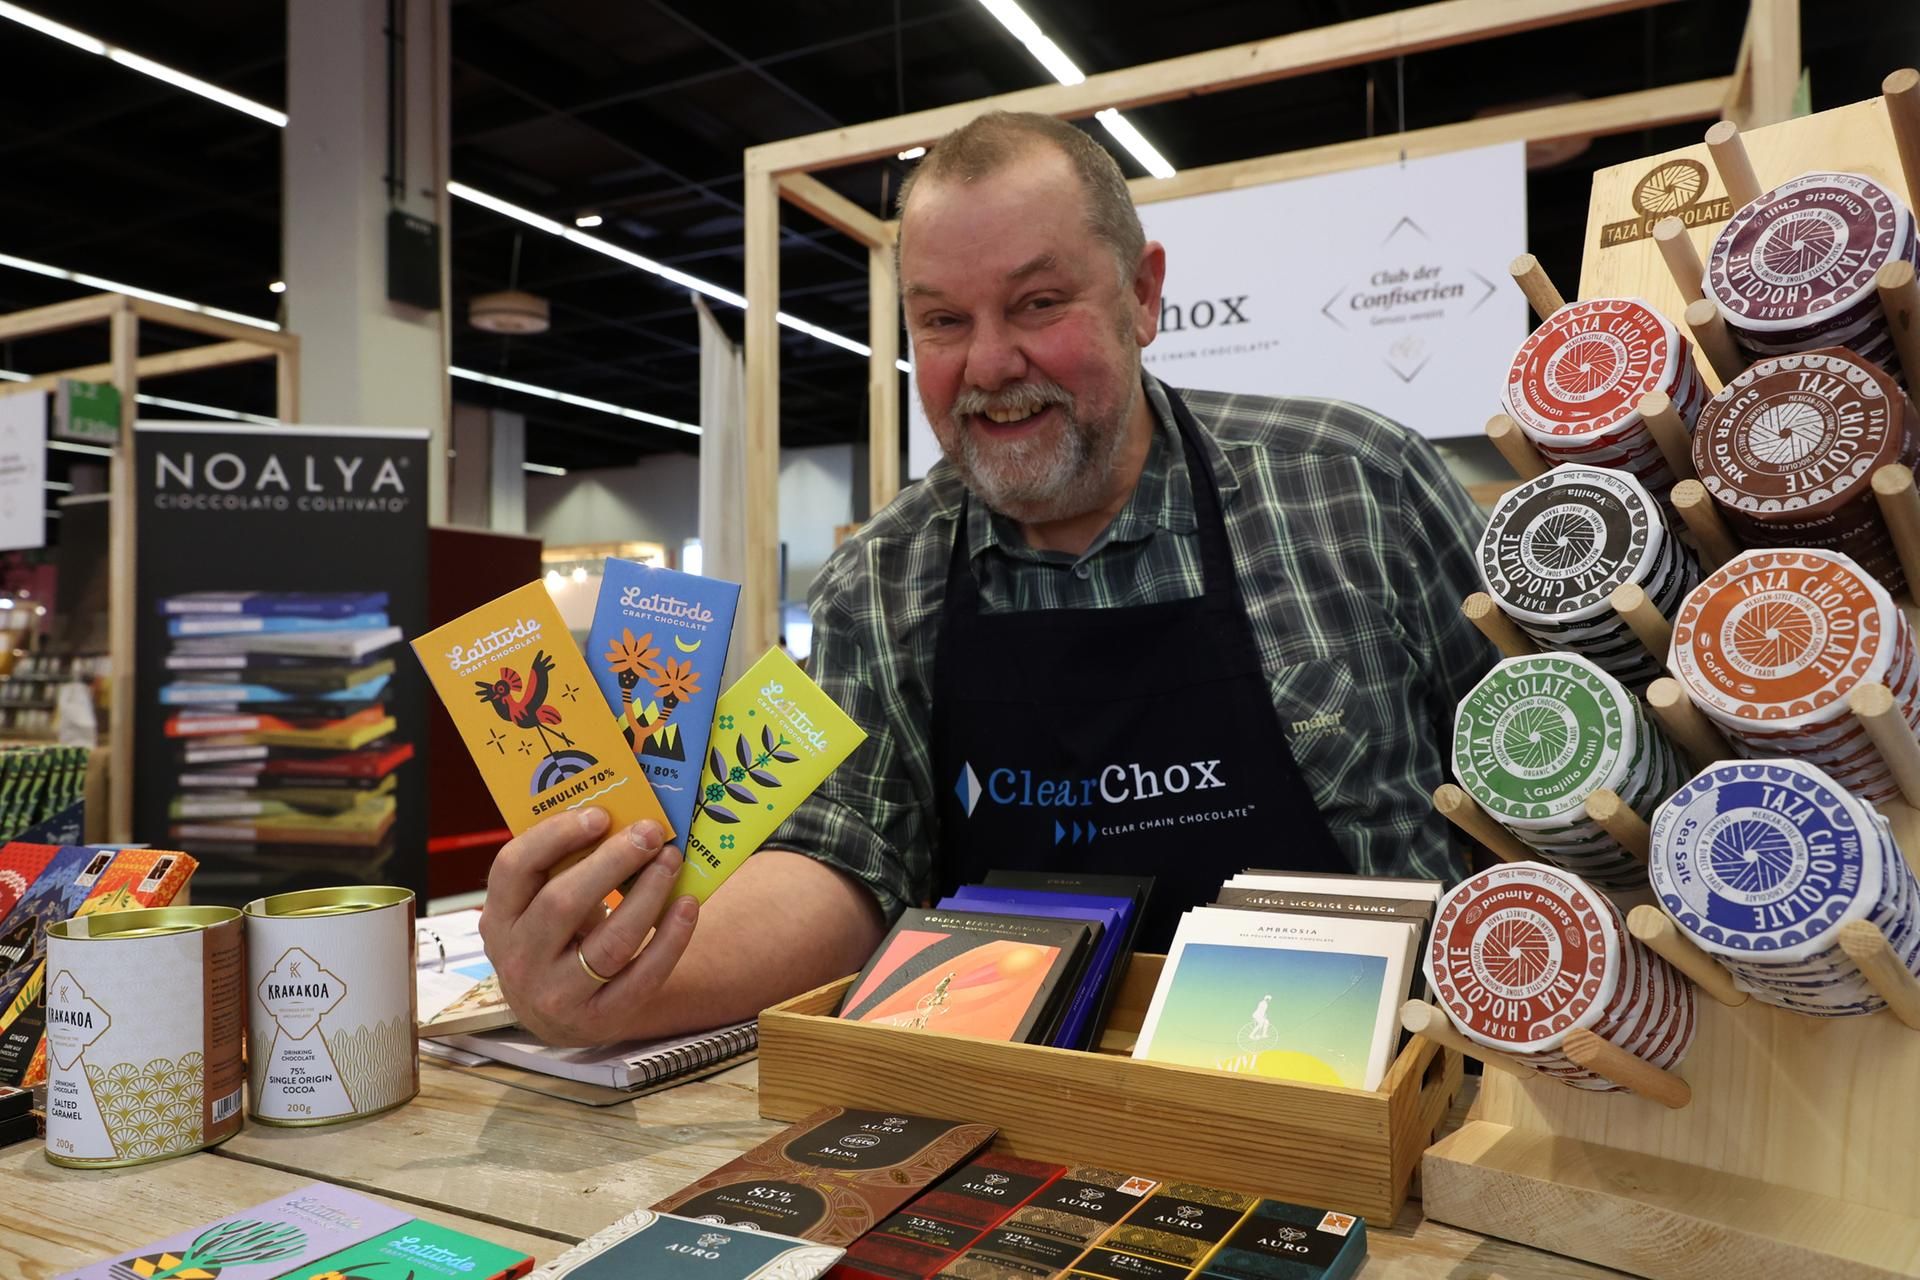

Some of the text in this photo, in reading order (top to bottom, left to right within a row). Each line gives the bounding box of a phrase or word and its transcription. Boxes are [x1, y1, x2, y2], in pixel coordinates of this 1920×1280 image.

[1764, 192, 1864, 219] Chipotle Chili
[1607, 223, 1638, 242] TAZA
[1370, 265, 1442, 288] Club der
[1730, 252, 1813, 304] CHOCOLATE
[1820, 249, 1864, 288] TAZA
[1350, 280, 1465, 312] Confiserien
[1633, 311, 1657, 333] DARK
[1759, 306, 1794, 317] DARK
[1560, 316, 1648, 398] TAZA CHOCOLATE
[1528, 379, 1563, 417] Cinnamon
[1797, 373, 1846, 402] TAZA
[1715, 389, 1760, 484] SUPER DARK
[1866, 408, 1884, 441] DARK
[1785, 401, 1864, 494] CHOCOLATE
[155, 493, 289, 511] CIOCCOLATO
[1567, 488, 1607, 506] Vanilla
[1542, 508, 1559, 519] TRADE
[1501, 533, 1564, 598] CHOCOLATE
[1574, 556, 1619, 591] TAZA
[1832, 572, 1866, 601] DARK
[620, 586, 714, 622] Latitude
[1515, 594, 1546, 611] DARK
[1744, 593, 1792, 608] MEXICAN-STYLE
[622, 609, 707, 631] CRAFT CHOCOLATE
[1736, 571, 1855, 679] TAZA CHOCOLATE
[444, 618, 542, 671] Latitude
[460, 633, 543, 677] CRAFT CHOCOLATE
[1703, 652, 1734, 688] Coffee
[1754, 669, 1776, 677] TRADE
[1472, 679, 1499, 706] DARK
[757, 698, 817, 757] CRAFT CHOCOLATE
[761, 679, 828, 752] Latitude
[1473, 677, 1576, 779] TAZA CHOCOLATE
[653, 766, 679, 779] 80%
[1523, 768, 1550, 776] ORGANIC
[1558, 747, 1574, 766] DIRECT
[1534, 770, 1581, 797] Guajillo
[1579, 739, 1598, 767] Chili
[532, 768, 615, 815] SEMULIKI 70%
[1101, 823, 1135, 836] CLEAR
[1140, 817, 1174, 830] CHAIN
[688, 833, 720, 869] COFFEE
[1675, 817, 1697, 885] Sea Salt
[1753, 786, 1837, 929] TAZA CHOCOLATE
[1838, 863, 1859, 892] DARK
[1482, 889, 1572, 926] Salted Almond
[1486, 914, 1503, 928] TRADE
[1506, 910, 1527, 918] DIRECT
[1257, 926, 1319, 936] AMBROSIA
[268, 983, 329, 1000] KRAKAKOA
[1450, 947, 1532, 1022] CHOCOLATE
[1538, 969, 1581, 1012] TAZA
[1482, 1018, 1516, 1039] DARK
[269, 1074, 332, 1085] SINGLE ORIGIN
[283, 1086, 315, 1094] COCOA
[51, 1108, 82, 1120] CARAMEL
[54, 1097, 77, 1109] SALTED
[287, 1103, 312, 1115] 200g
[860, 1123, 903, 1133] AURO
[56, 1138, 74, 1153] 200g
[747, 1187, 796, 1204] 85%
[962, 1180, 1006, 1196] AURO
[1057, 1196, 1102, 1211] AURO
[1154, 1214, 1203, 1230] AURO
[389, 1235, 478, 1272] Latitude
[665, 1243, 720, 1260] AURO
[1257, 1236, 1309, 1254] AURO
